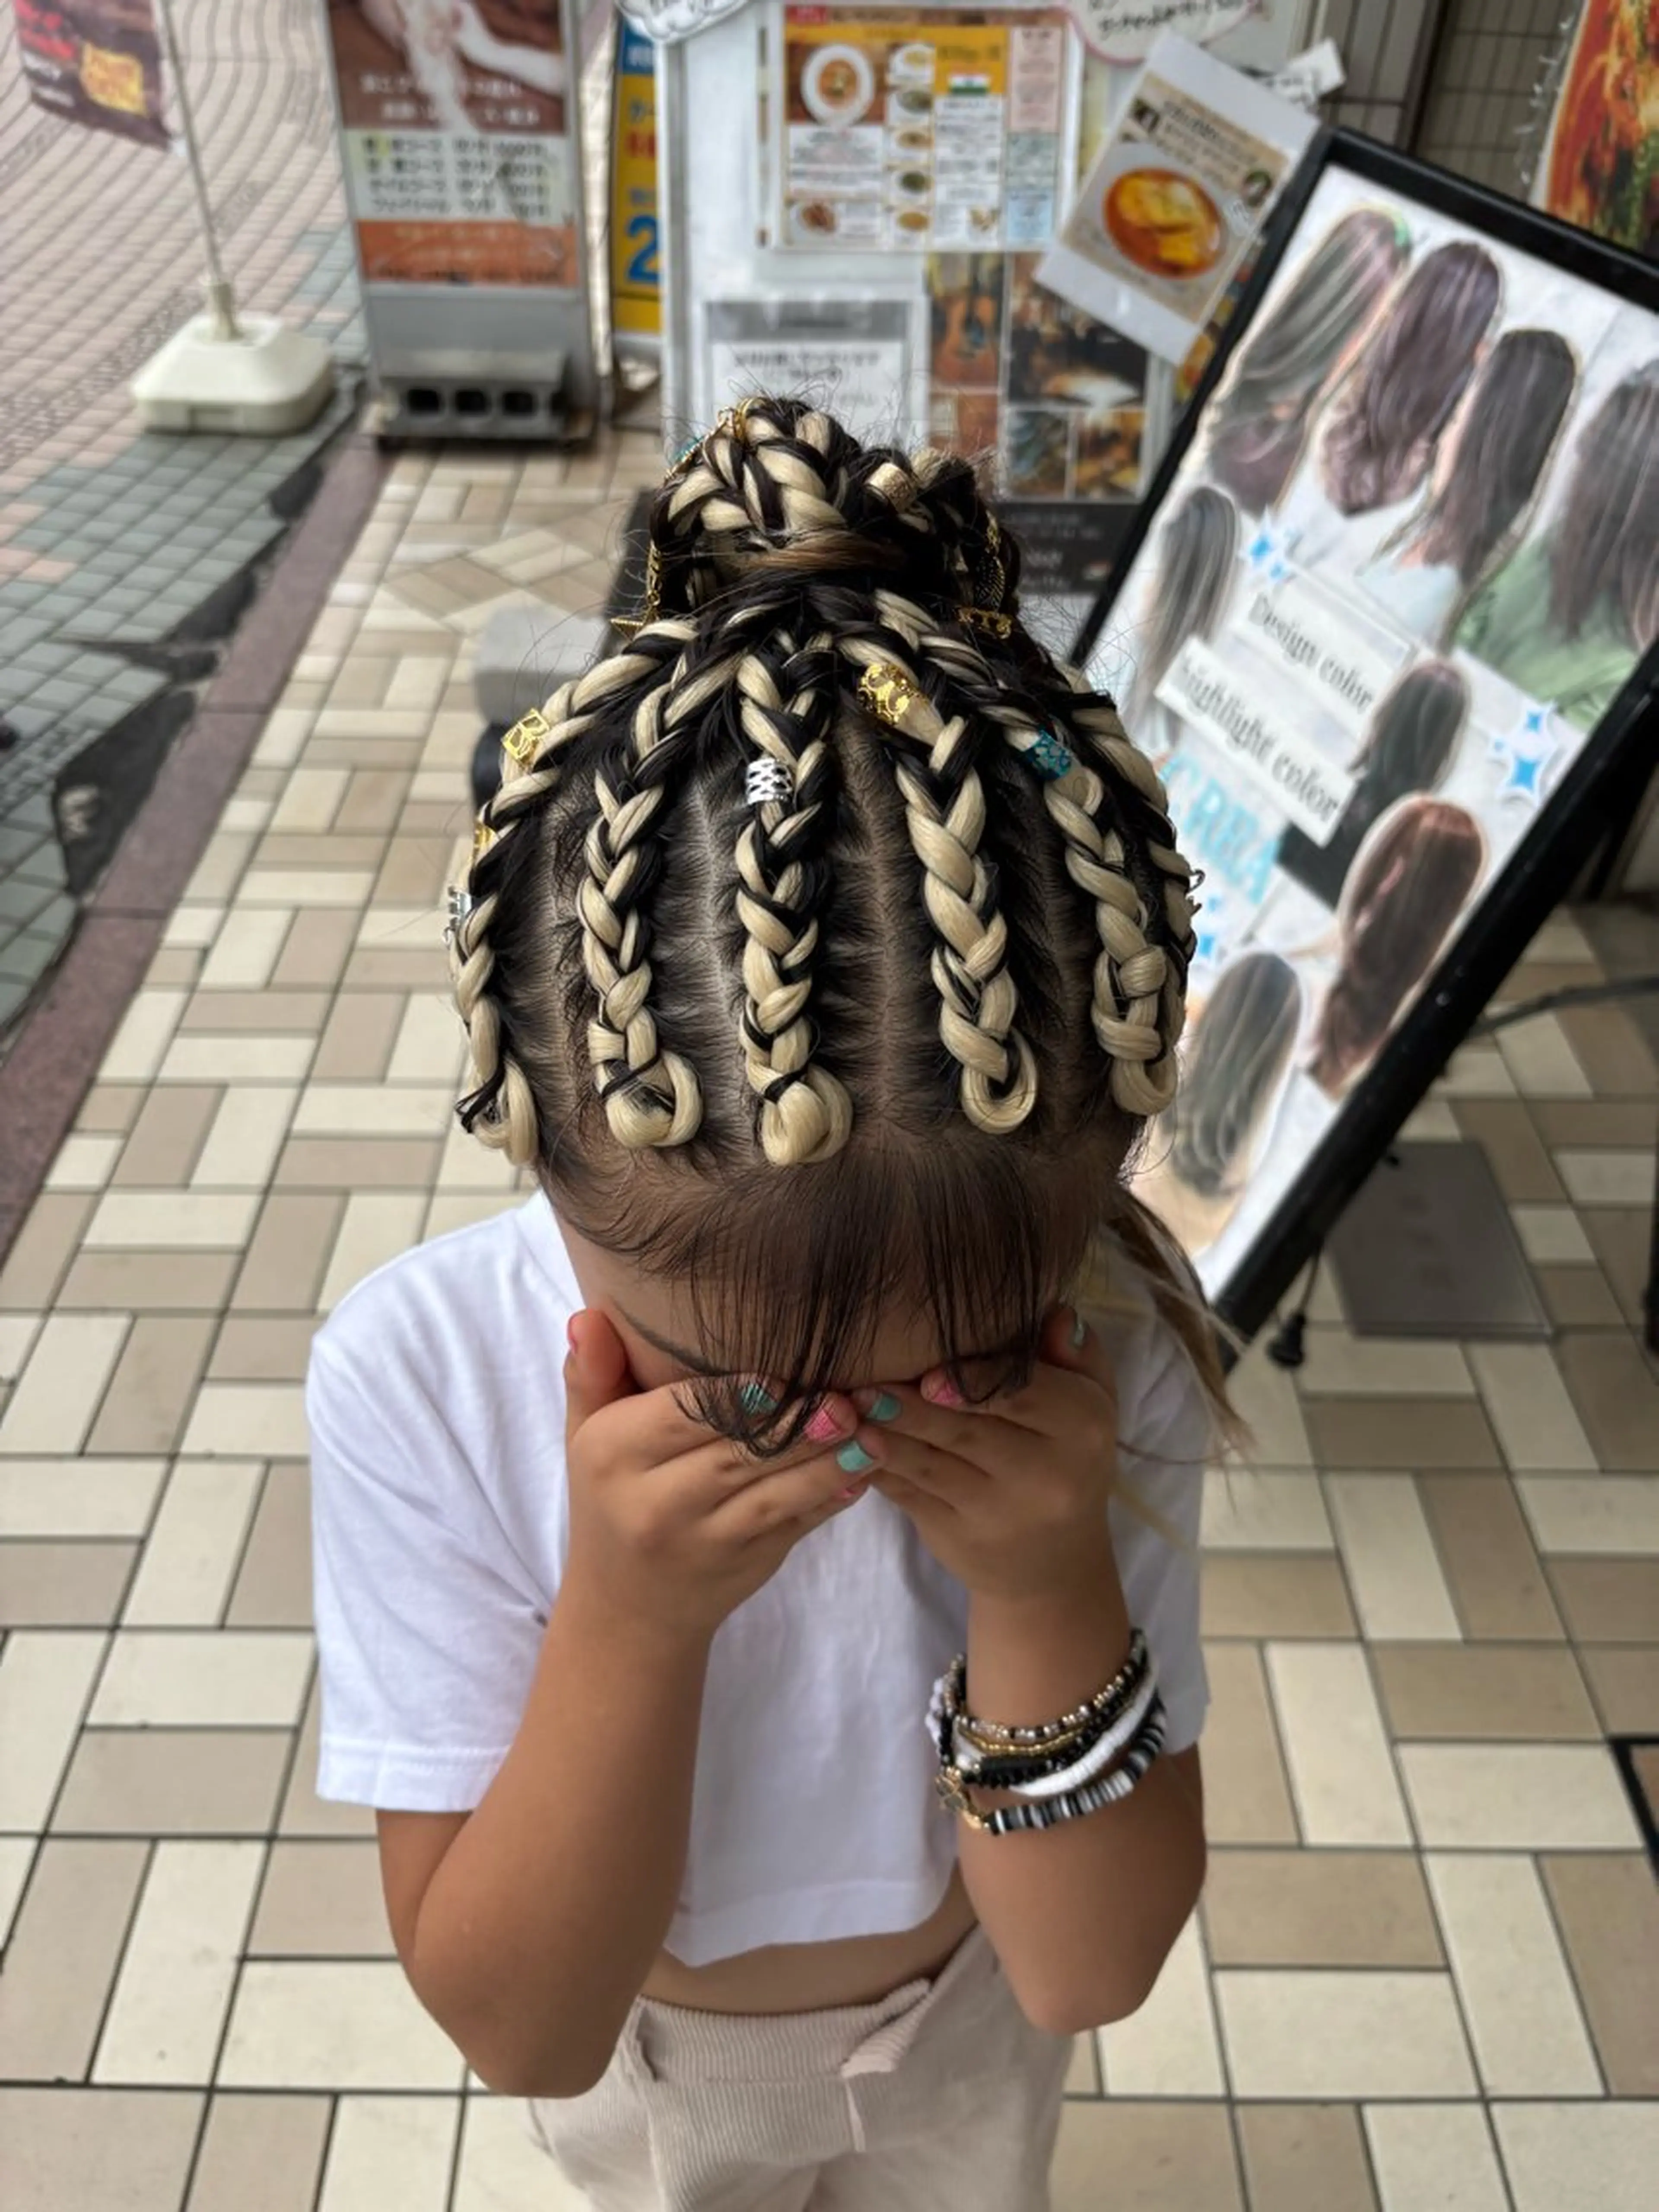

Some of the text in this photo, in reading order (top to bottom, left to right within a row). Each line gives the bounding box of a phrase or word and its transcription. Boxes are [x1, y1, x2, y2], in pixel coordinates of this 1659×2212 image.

[1248, 591, 1373, 714] Design color
[1274, 753, 1339, 821] color
